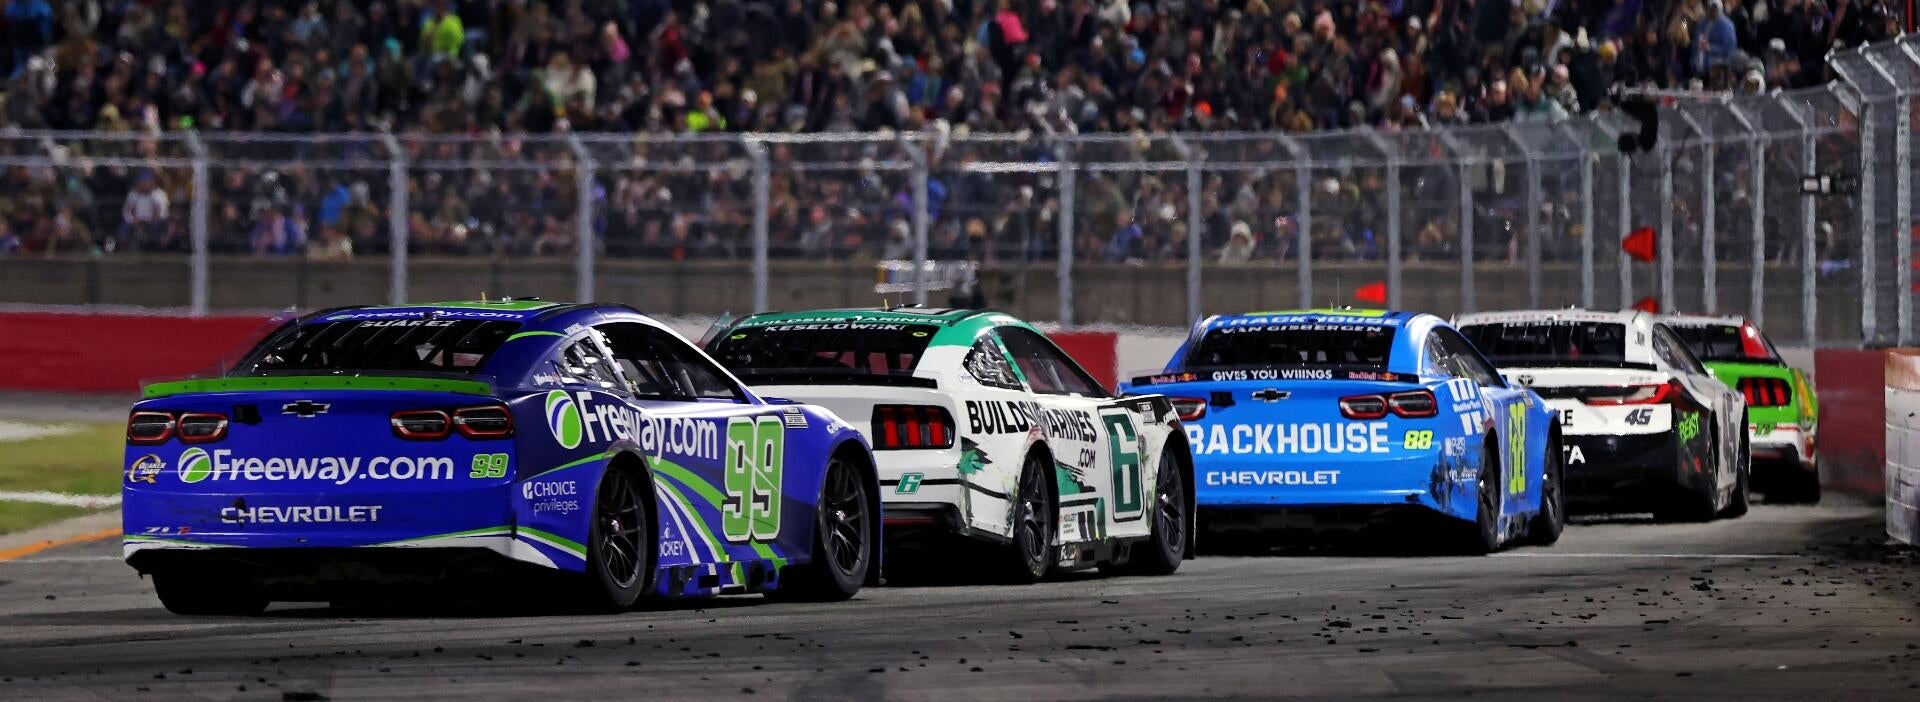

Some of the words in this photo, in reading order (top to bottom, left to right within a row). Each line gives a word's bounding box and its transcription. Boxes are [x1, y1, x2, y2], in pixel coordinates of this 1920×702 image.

[1212, 371, 1247, 381] GIVES
[1251, 369, 1278, 380] YOU
[1625, 408, 1654, 425] 45
[576, 390, 718, 465] Freeway.com
[1184, 421, 1390, 455] RACKHOUSE
[1403, 429, 1434, 450] 88
[211, 449, 454, 485] Freeway.com
[469, 453, 508, 478] 99
[1077, 448, 1096, 468] .COM
[1100, 408, 1144, 518] 6
[721, 415, 785, 544] 99
[895, 472, 925, 495] 6
[1206, 470, 1341, 486] CHEVROLET
[533, 481, 577, 497] CHOICE
[220, 505, 383, 524] CHEVROLET
[533, 498, 580, 517] privileges
